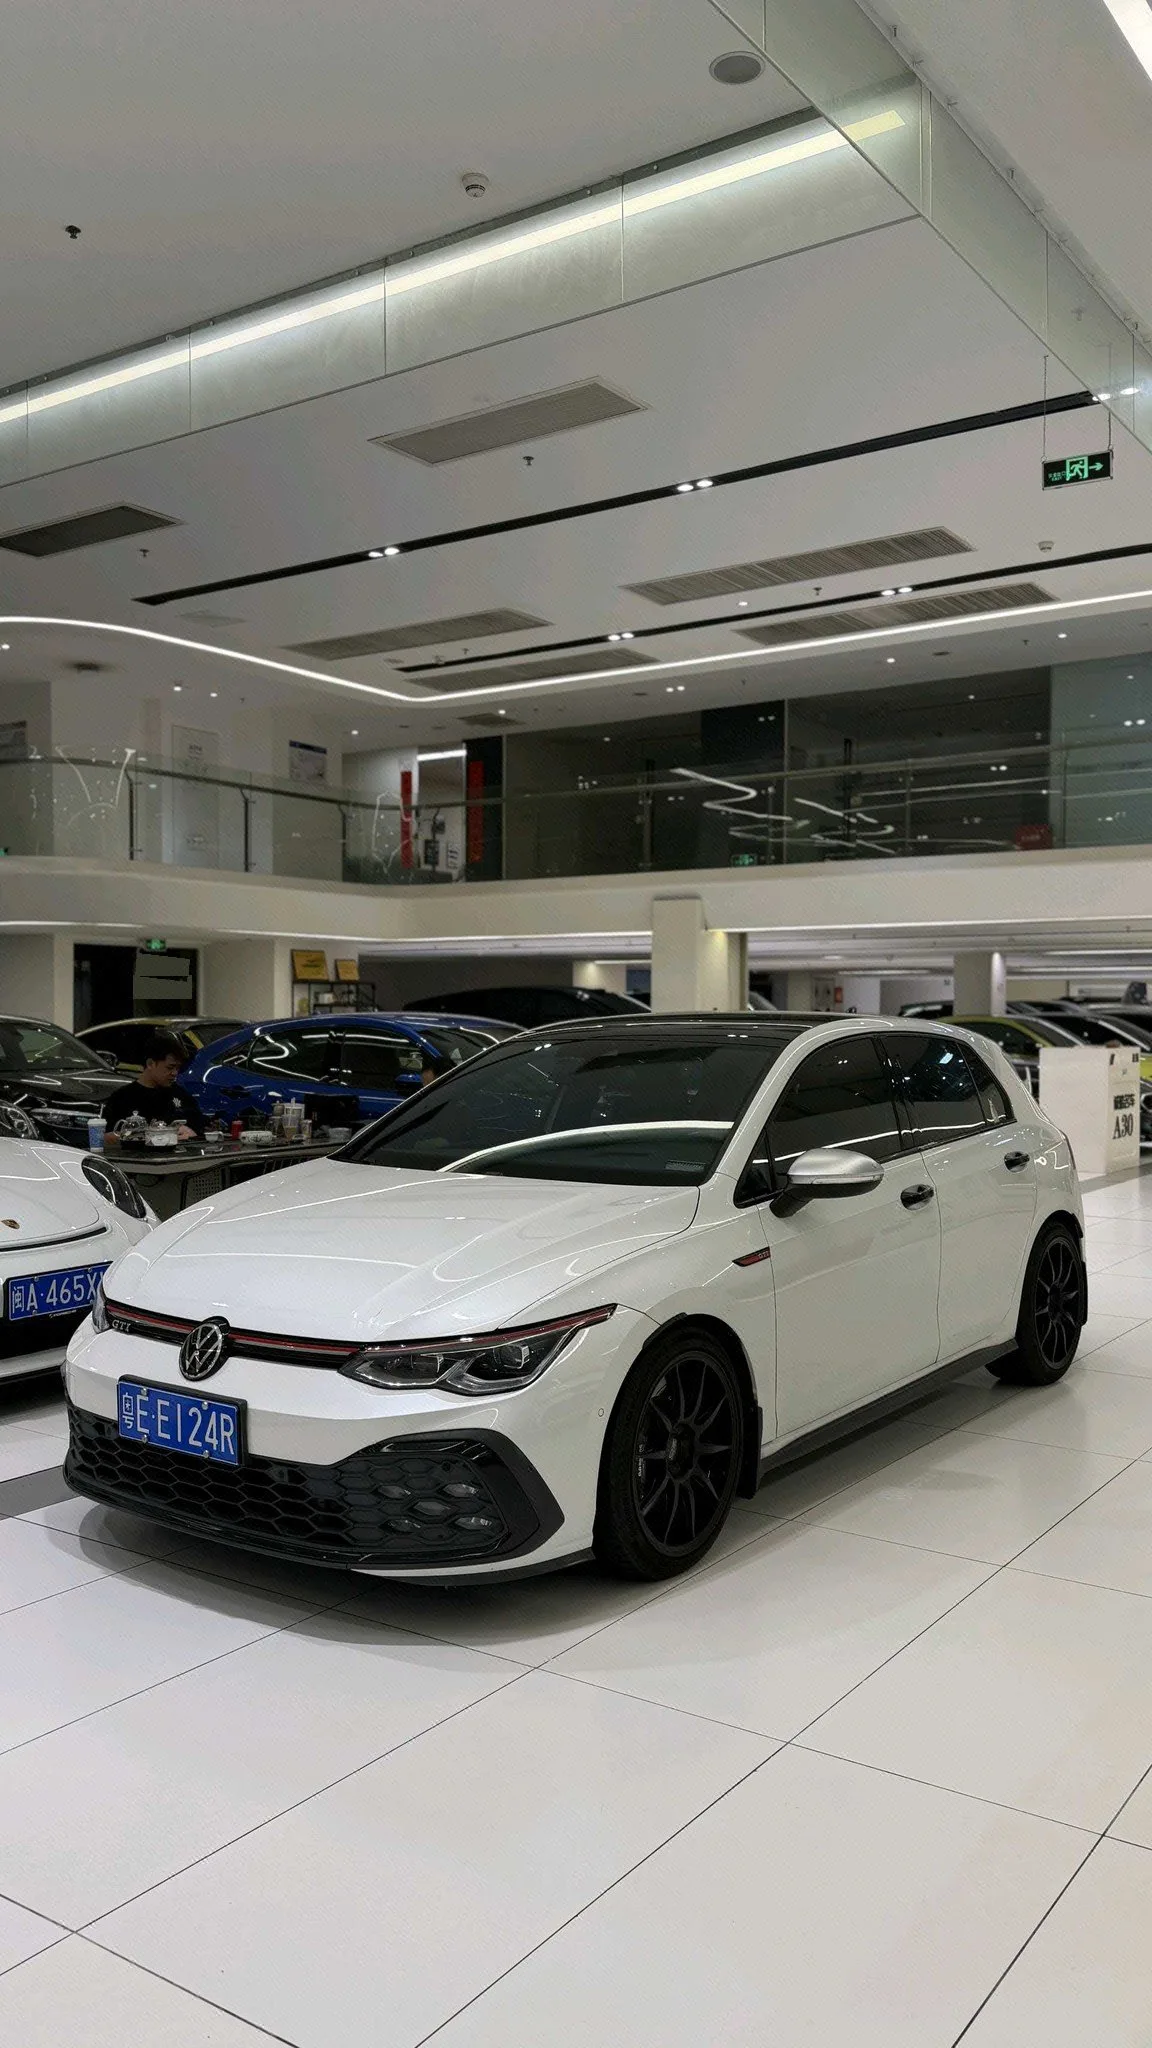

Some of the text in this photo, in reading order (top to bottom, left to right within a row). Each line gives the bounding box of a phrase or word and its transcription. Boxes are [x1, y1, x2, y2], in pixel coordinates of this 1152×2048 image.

[1112, 1113, 1134, 1139] A30
[12, 1271, 104, 1313] 闽A·465X
[111, 1319, 131, 1332] GTI
[122, 1392, 235, 1455] 粤E·E124R
